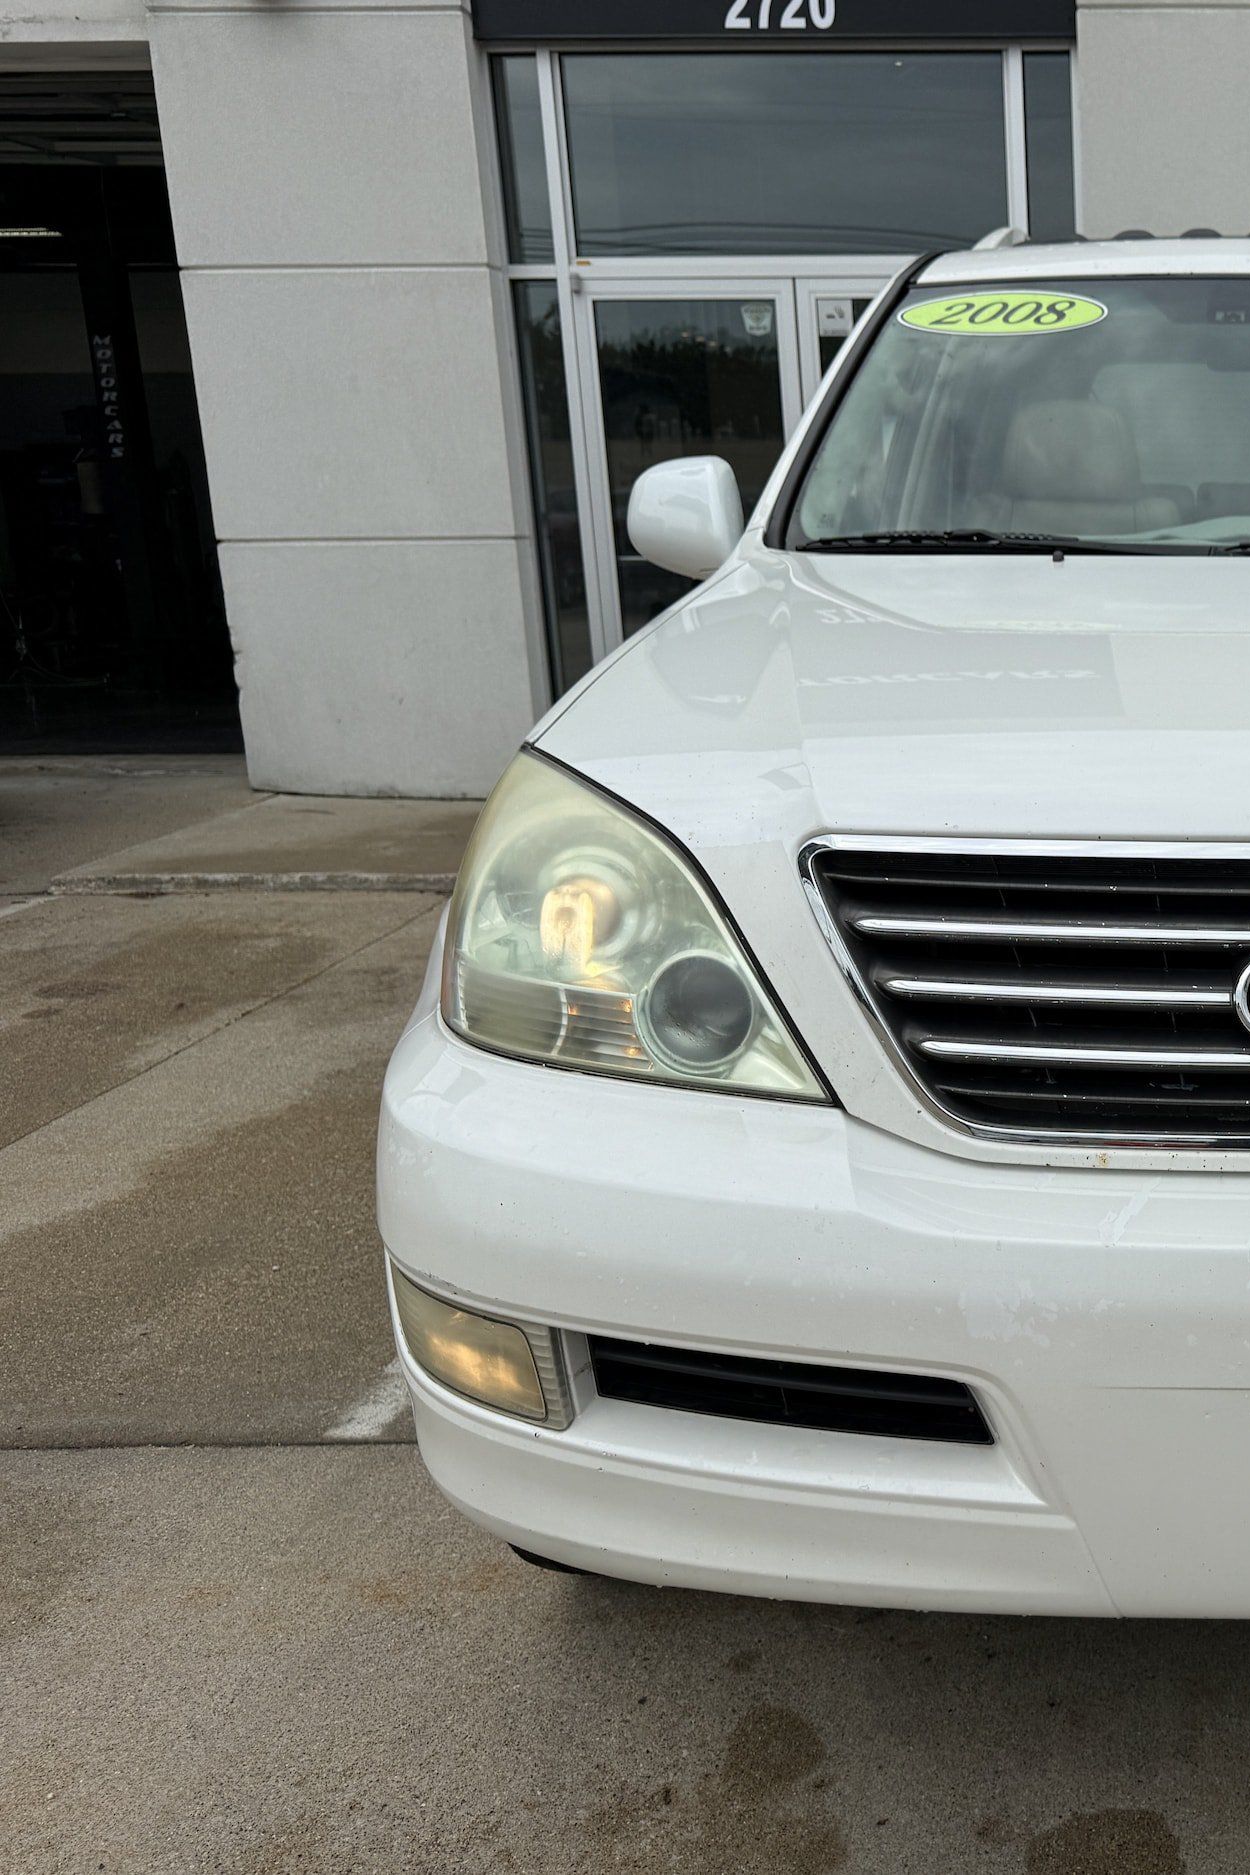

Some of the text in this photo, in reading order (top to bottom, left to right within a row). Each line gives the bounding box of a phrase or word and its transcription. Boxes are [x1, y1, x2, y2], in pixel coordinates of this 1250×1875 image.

[724, 0, 836, 29] 2720
[928, 299, 1076, 327] 2008
[93, 334, 125, 459] MOTORCARS
